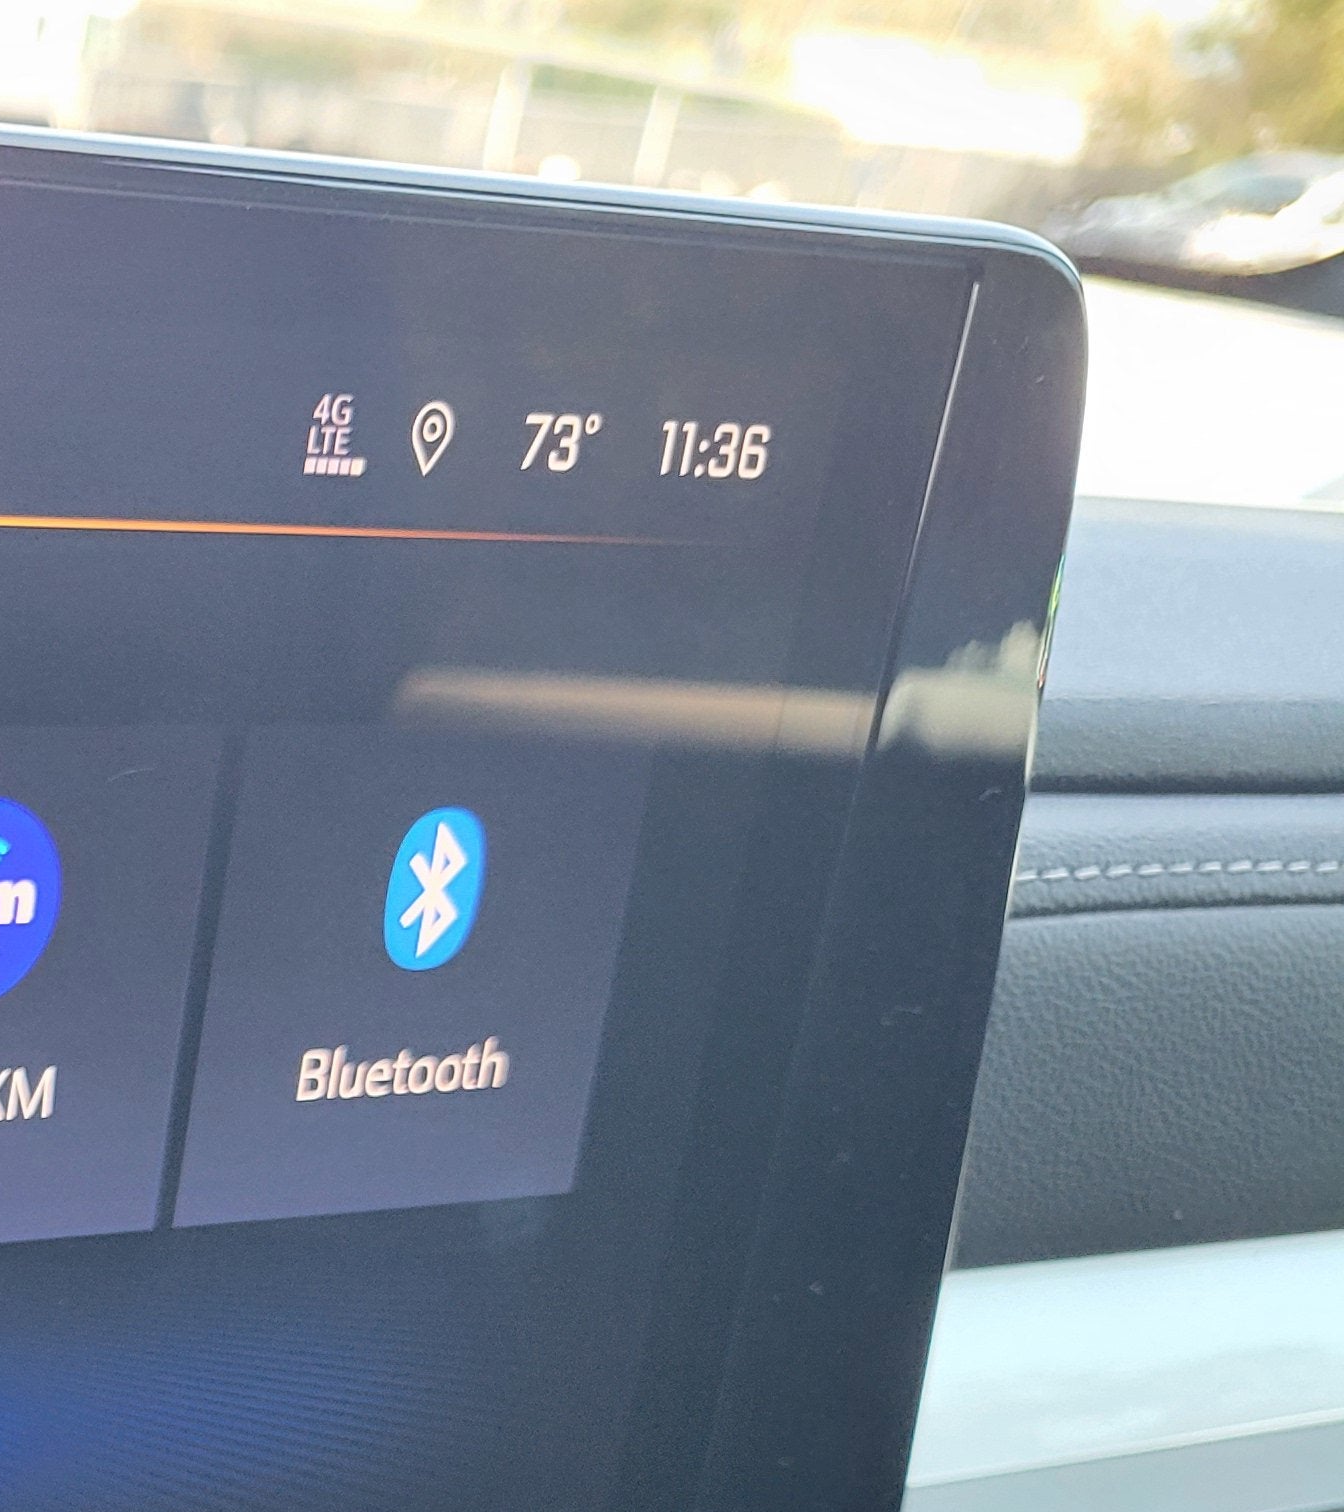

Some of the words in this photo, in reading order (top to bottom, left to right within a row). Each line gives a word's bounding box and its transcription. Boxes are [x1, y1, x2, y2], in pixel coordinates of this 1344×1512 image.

[313, 393, 354, 425] 4G
[306, 426, 353, 455] LTE
[520, 411, 604, 473] 73°
[659, 420, 772, 479] 11:36
[295, 1034, 510, 1103] Bluetooth
